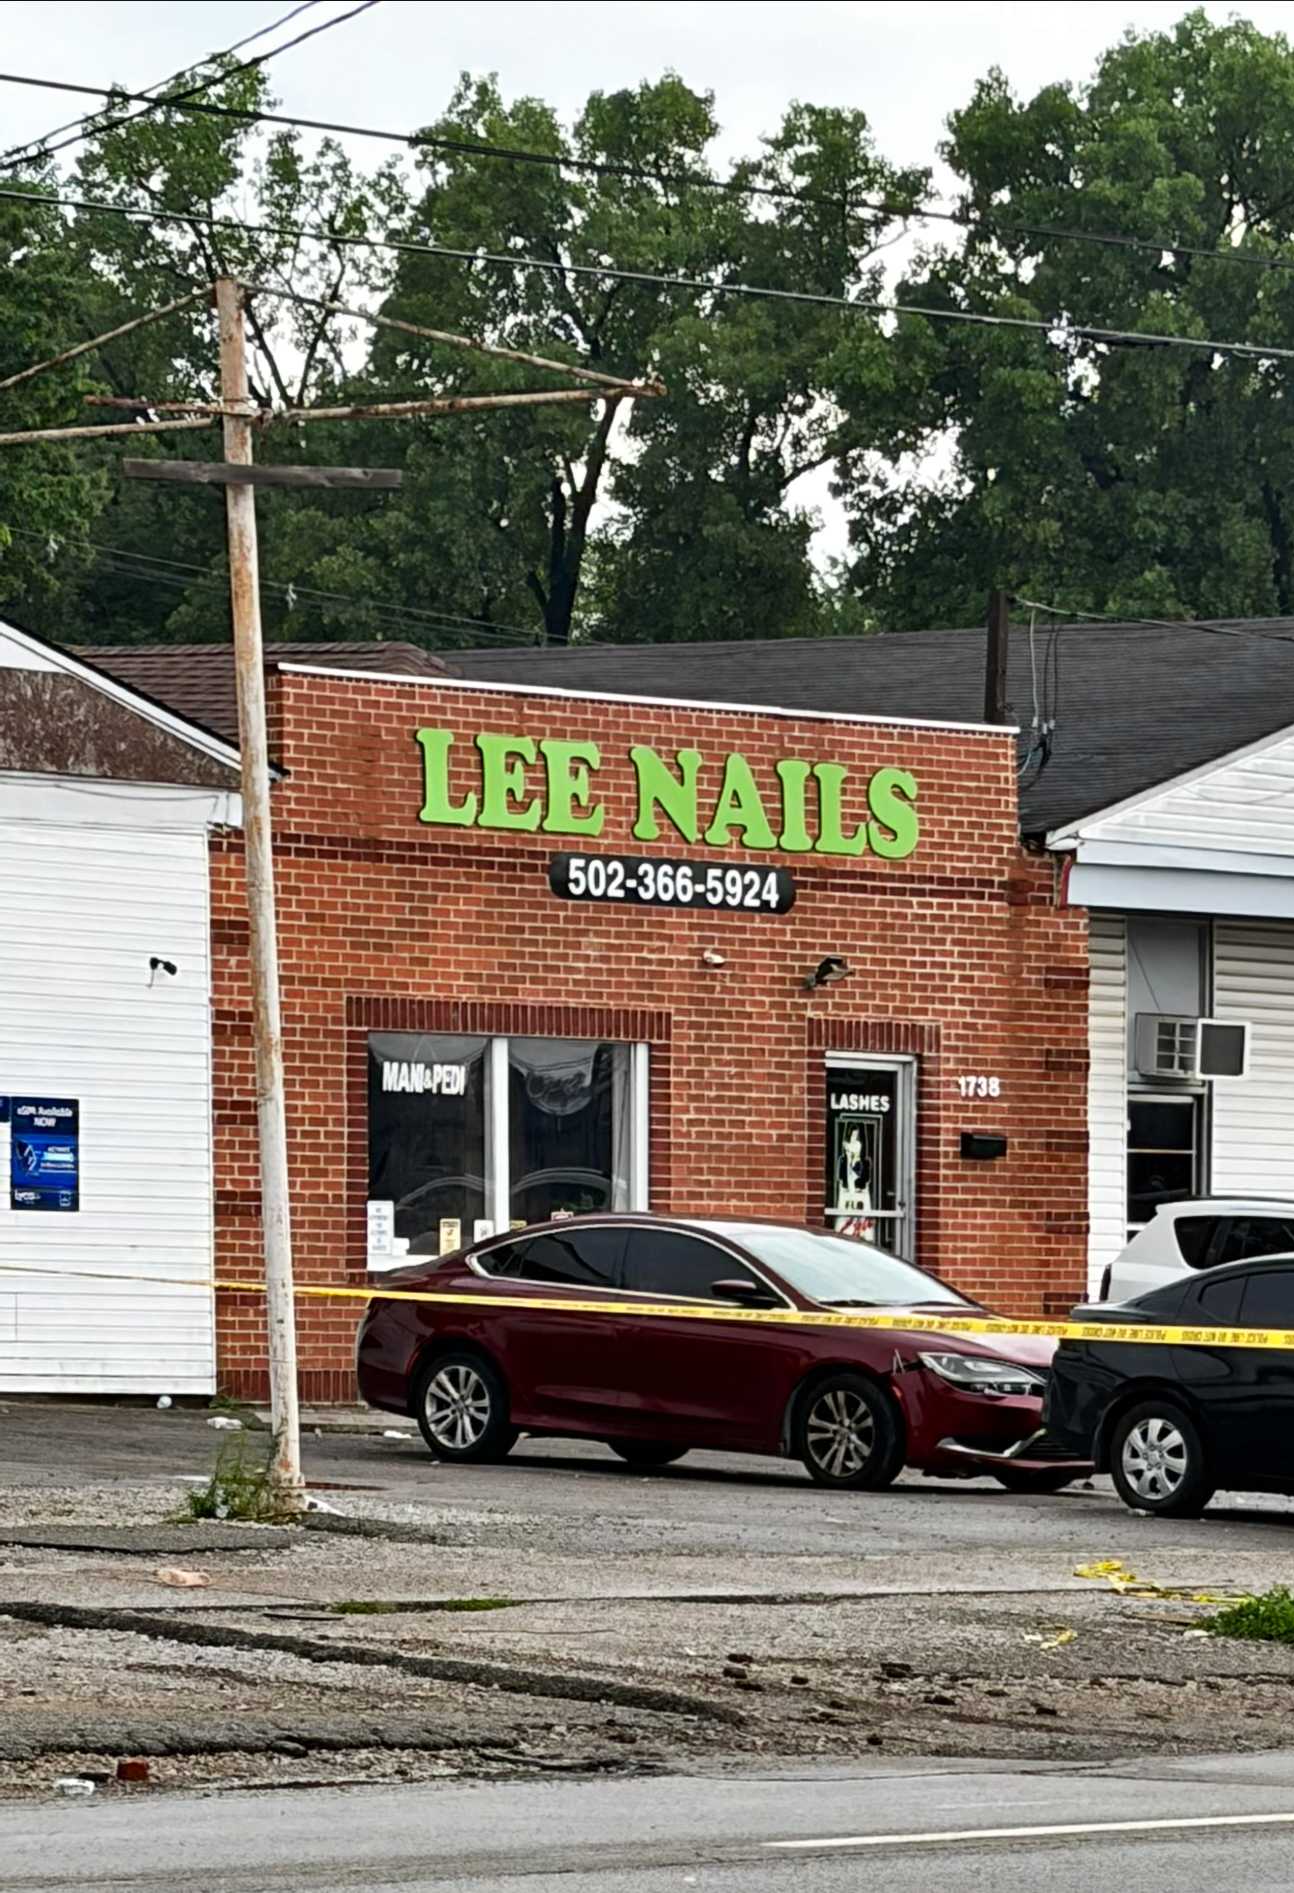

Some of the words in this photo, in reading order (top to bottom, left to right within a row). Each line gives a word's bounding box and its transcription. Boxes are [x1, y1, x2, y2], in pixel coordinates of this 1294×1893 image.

[416, 728, 604, 837] LEE
[630, 746, 920, 859] NAILS
[568, 858, 780, 909] 502-366-5924
[830, 1093, 890, 1112] LASHES
[958, 1076, 1001, 1097] 1738
